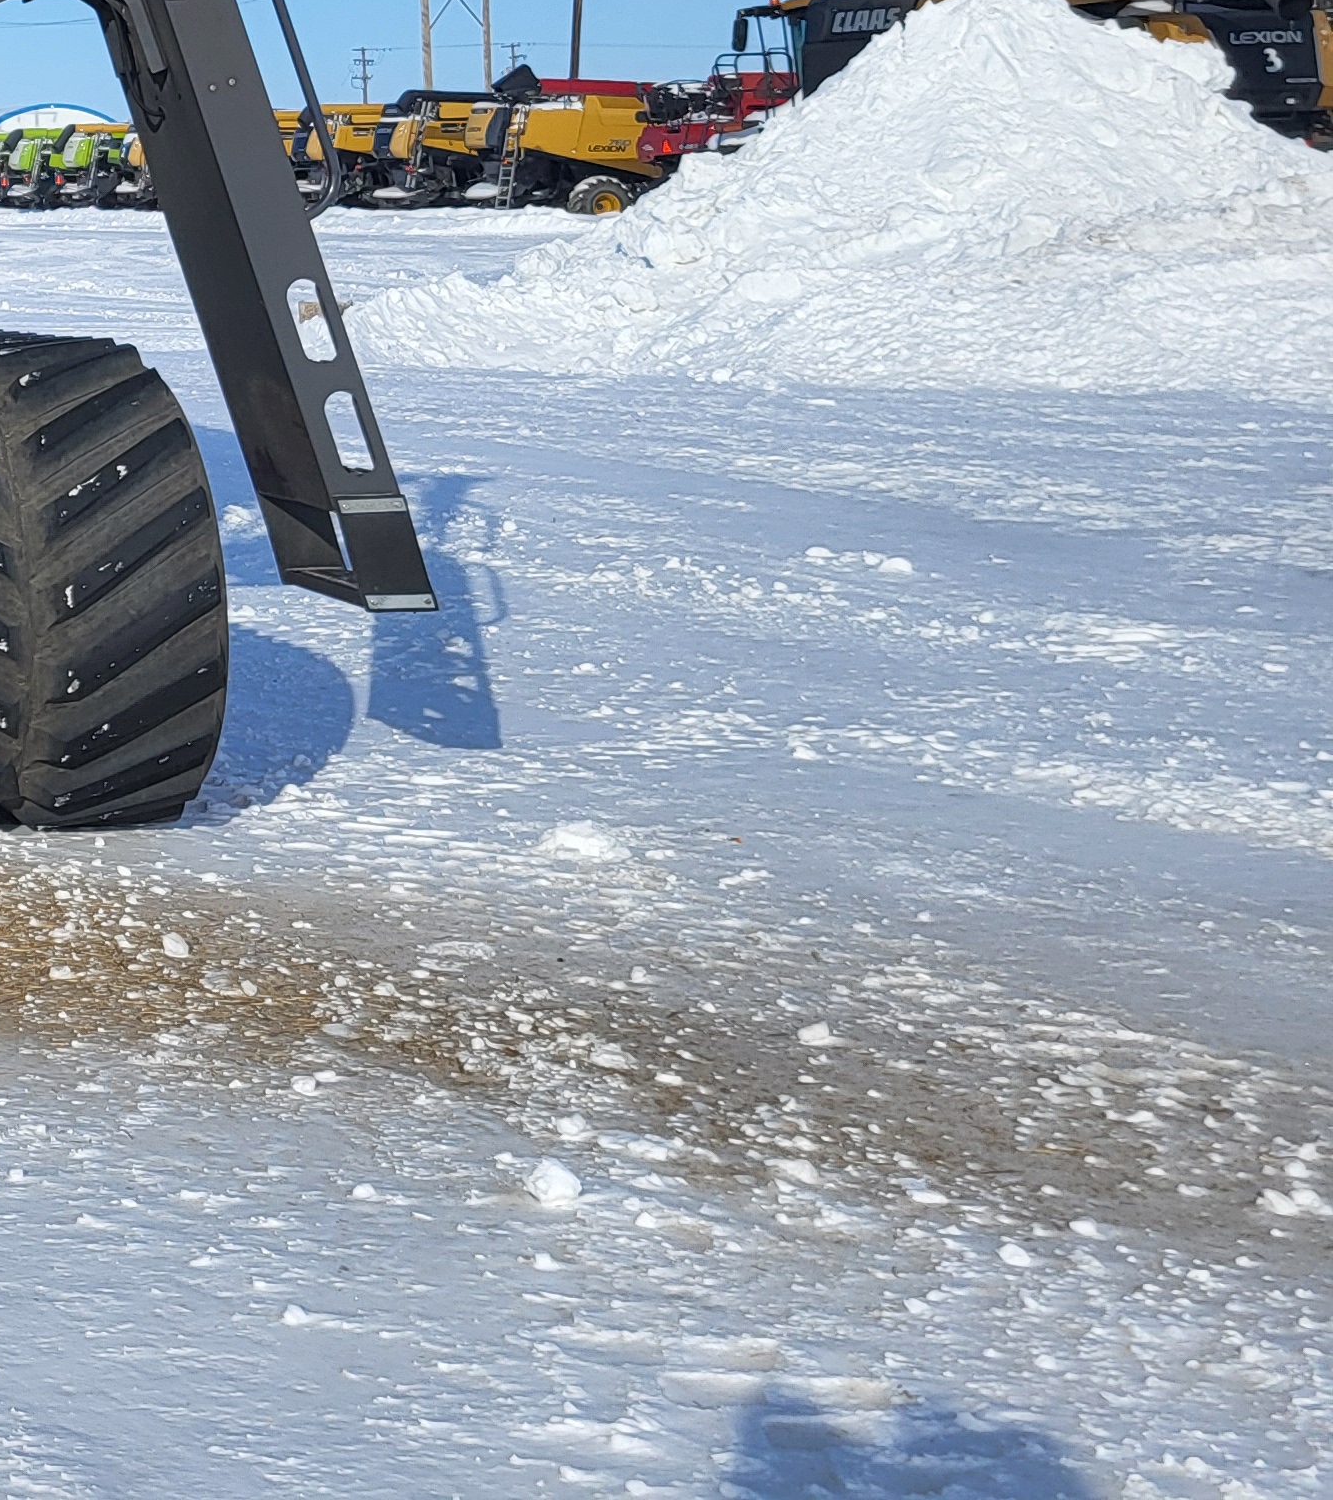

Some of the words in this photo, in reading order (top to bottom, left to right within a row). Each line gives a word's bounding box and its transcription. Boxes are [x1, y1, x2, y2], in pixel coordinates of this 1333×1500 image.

[832, 7, 901, 32] CLAAS
[1229, 30, 1304, 45] LEXION
[1263, 47, 1284, 73] 3
[587, 144, 627, 153] LEXION
